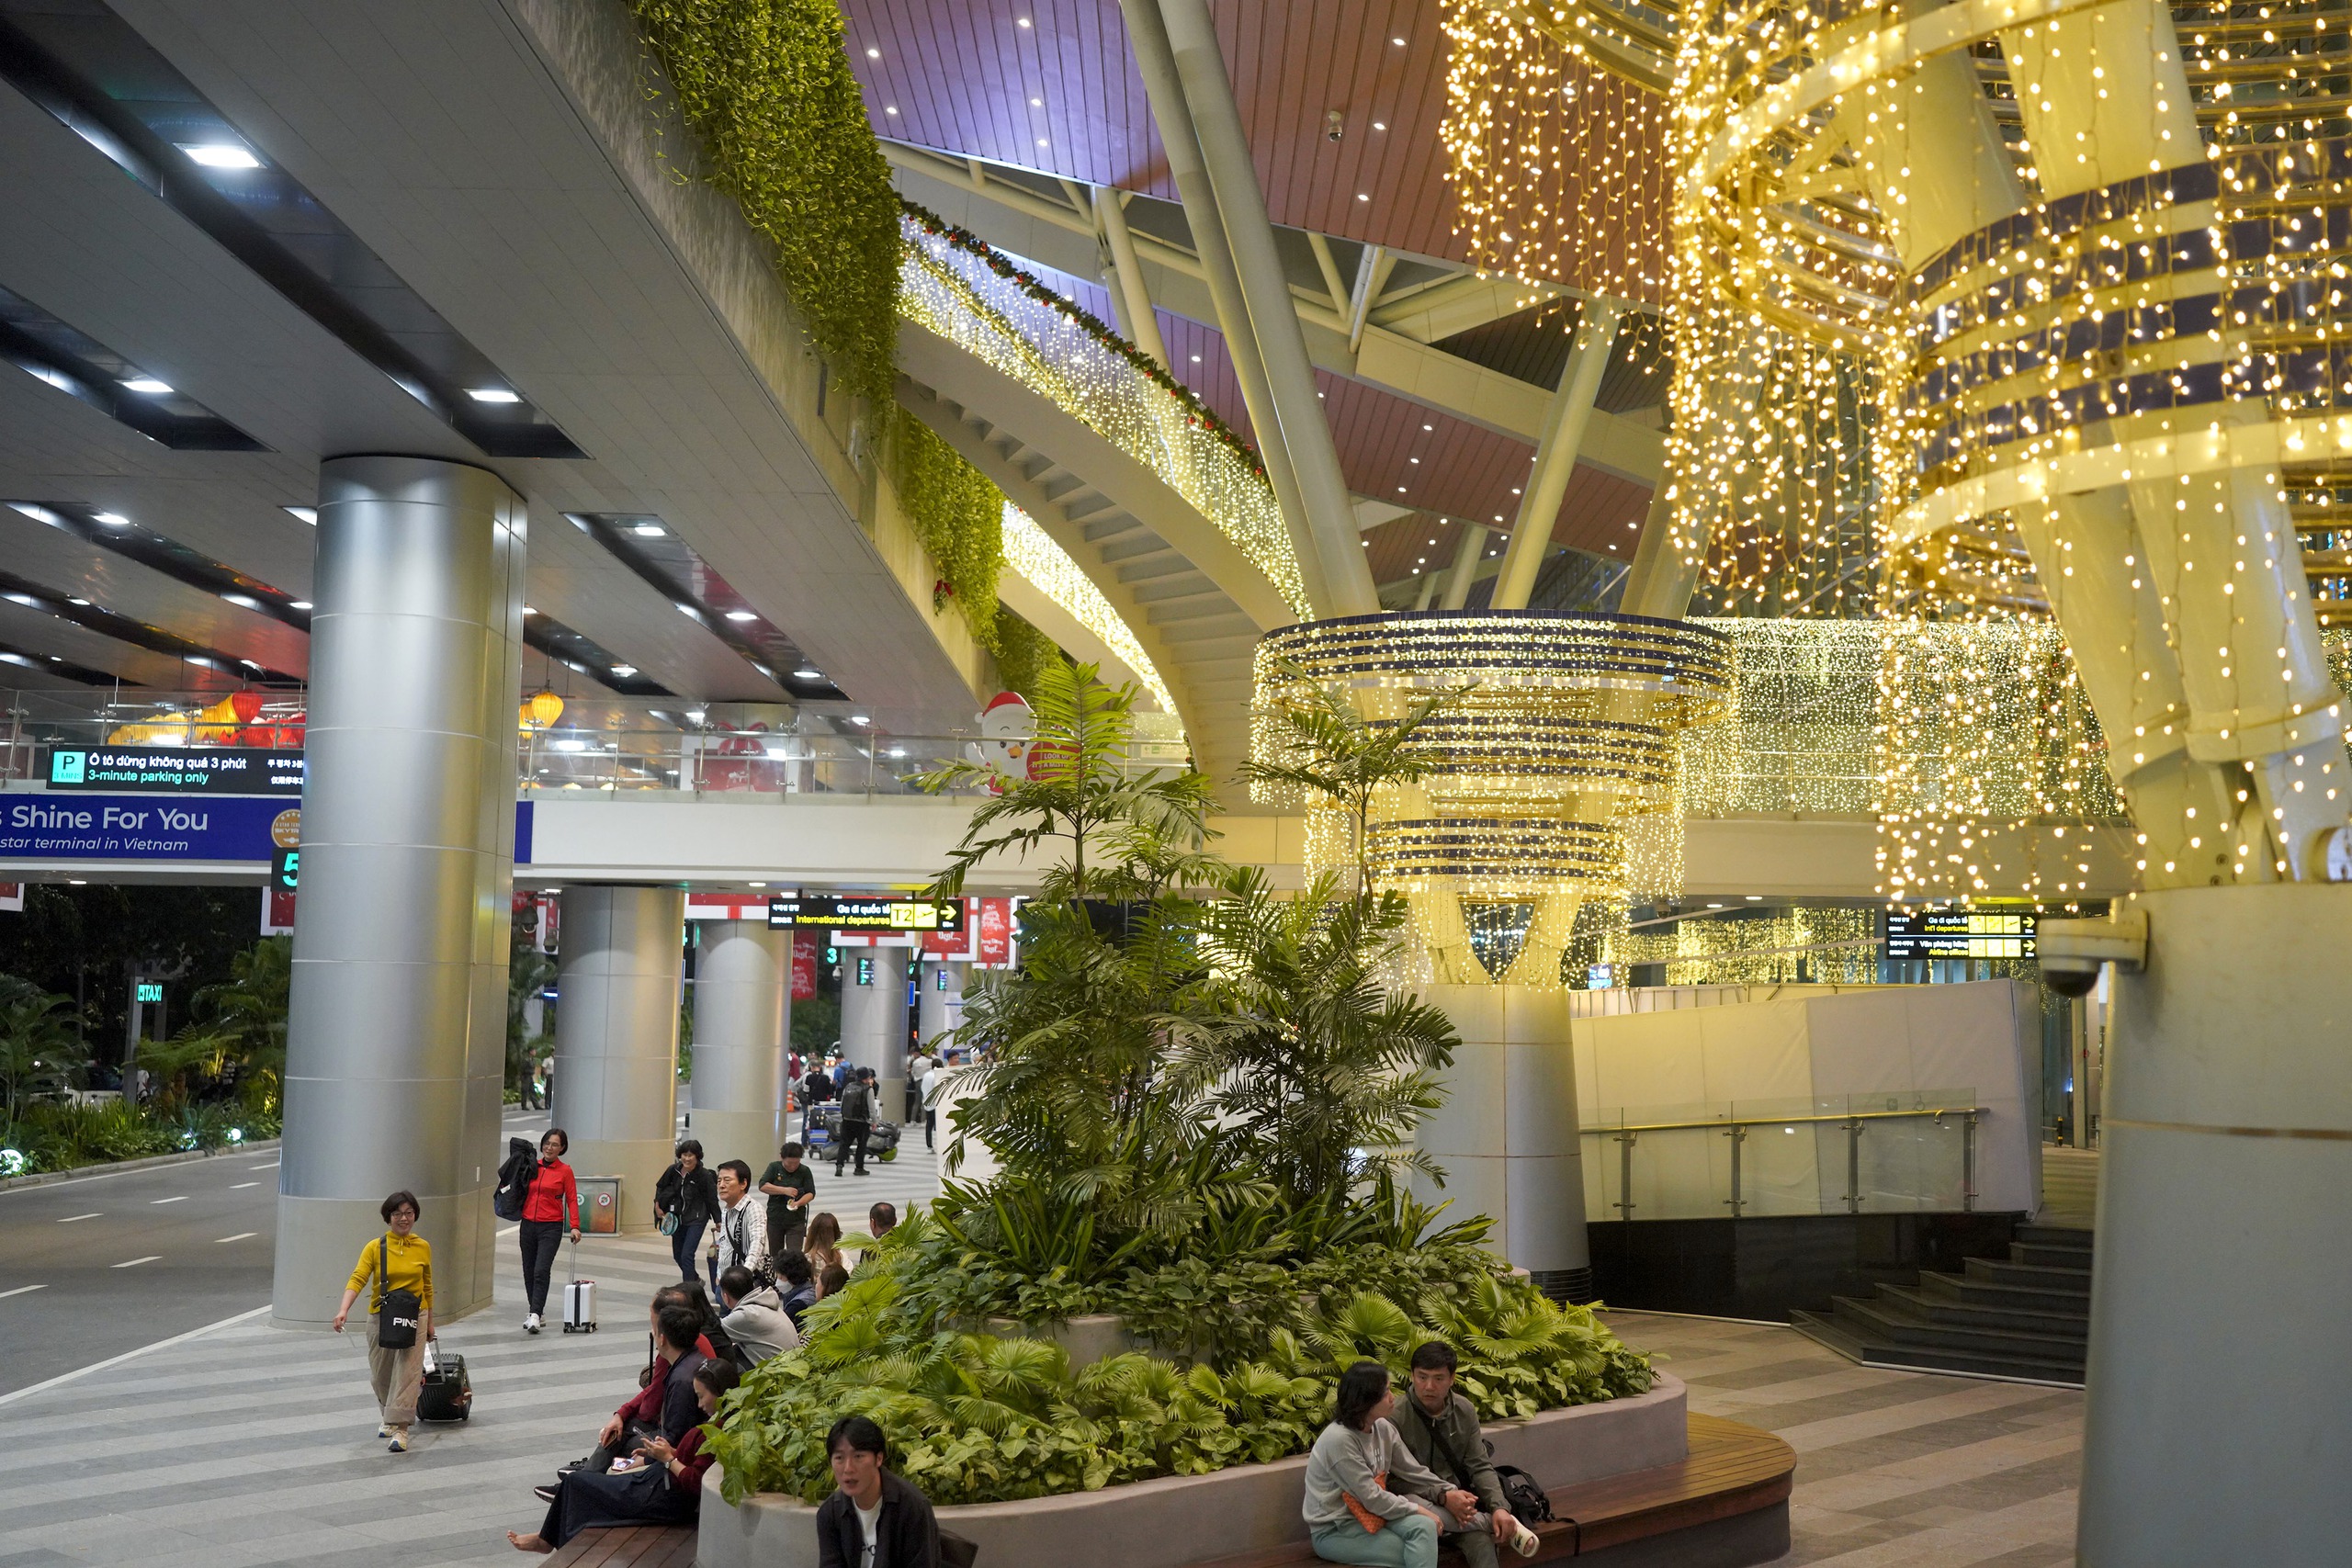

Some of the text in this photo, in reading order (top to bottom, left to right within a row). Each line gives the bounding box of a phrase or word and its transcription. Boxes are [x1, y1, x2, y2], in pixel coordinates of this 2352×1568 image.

[62, 755, 75, 770] P
[89, 751, 247, 771] Ô tô dừng không quá 3 phút
[88, 769, 209, 785] 3-minute parking only
[11, 805, 92, 829] Shine
[103, 807, 149, 829] For
[157, 807, 208, 831] You
[0, 836, 188, 851] star terminal in Vietnam
[796, 915, 845, 925] International
[847, 916, 890, 926] departures
[892, 908, 912, 921] T2
[827, 947, 838, 964] 3
[144, 985, 163, 1001] TAXI
